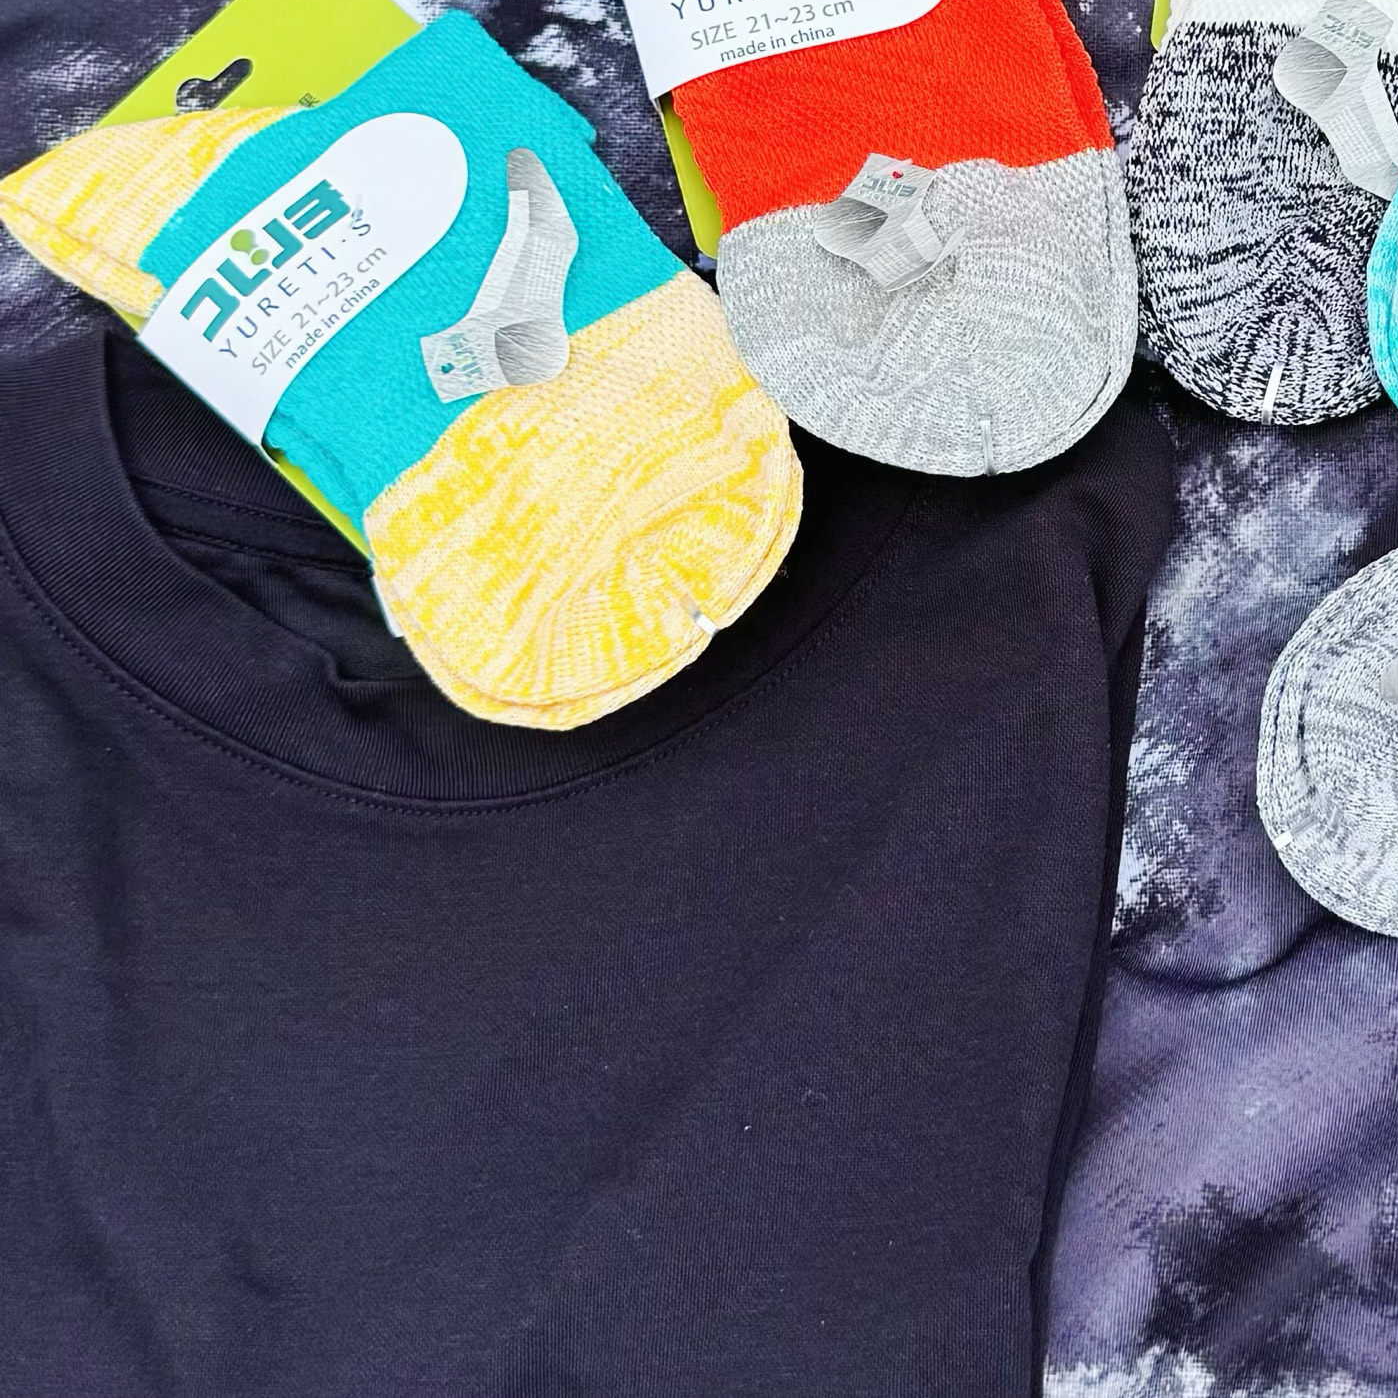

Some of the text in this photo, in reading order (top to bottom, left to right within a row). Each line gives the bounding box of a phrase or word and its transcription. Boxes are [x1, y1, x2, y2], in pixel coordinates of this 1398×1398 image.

[690, 0, 855, 50] SIZE 21~23 cm
[720, 25, 835, 63] made in china
[251, 245, 388, 376] SIZE 21~23 cm
[285, 277, 381, 370] made in china
